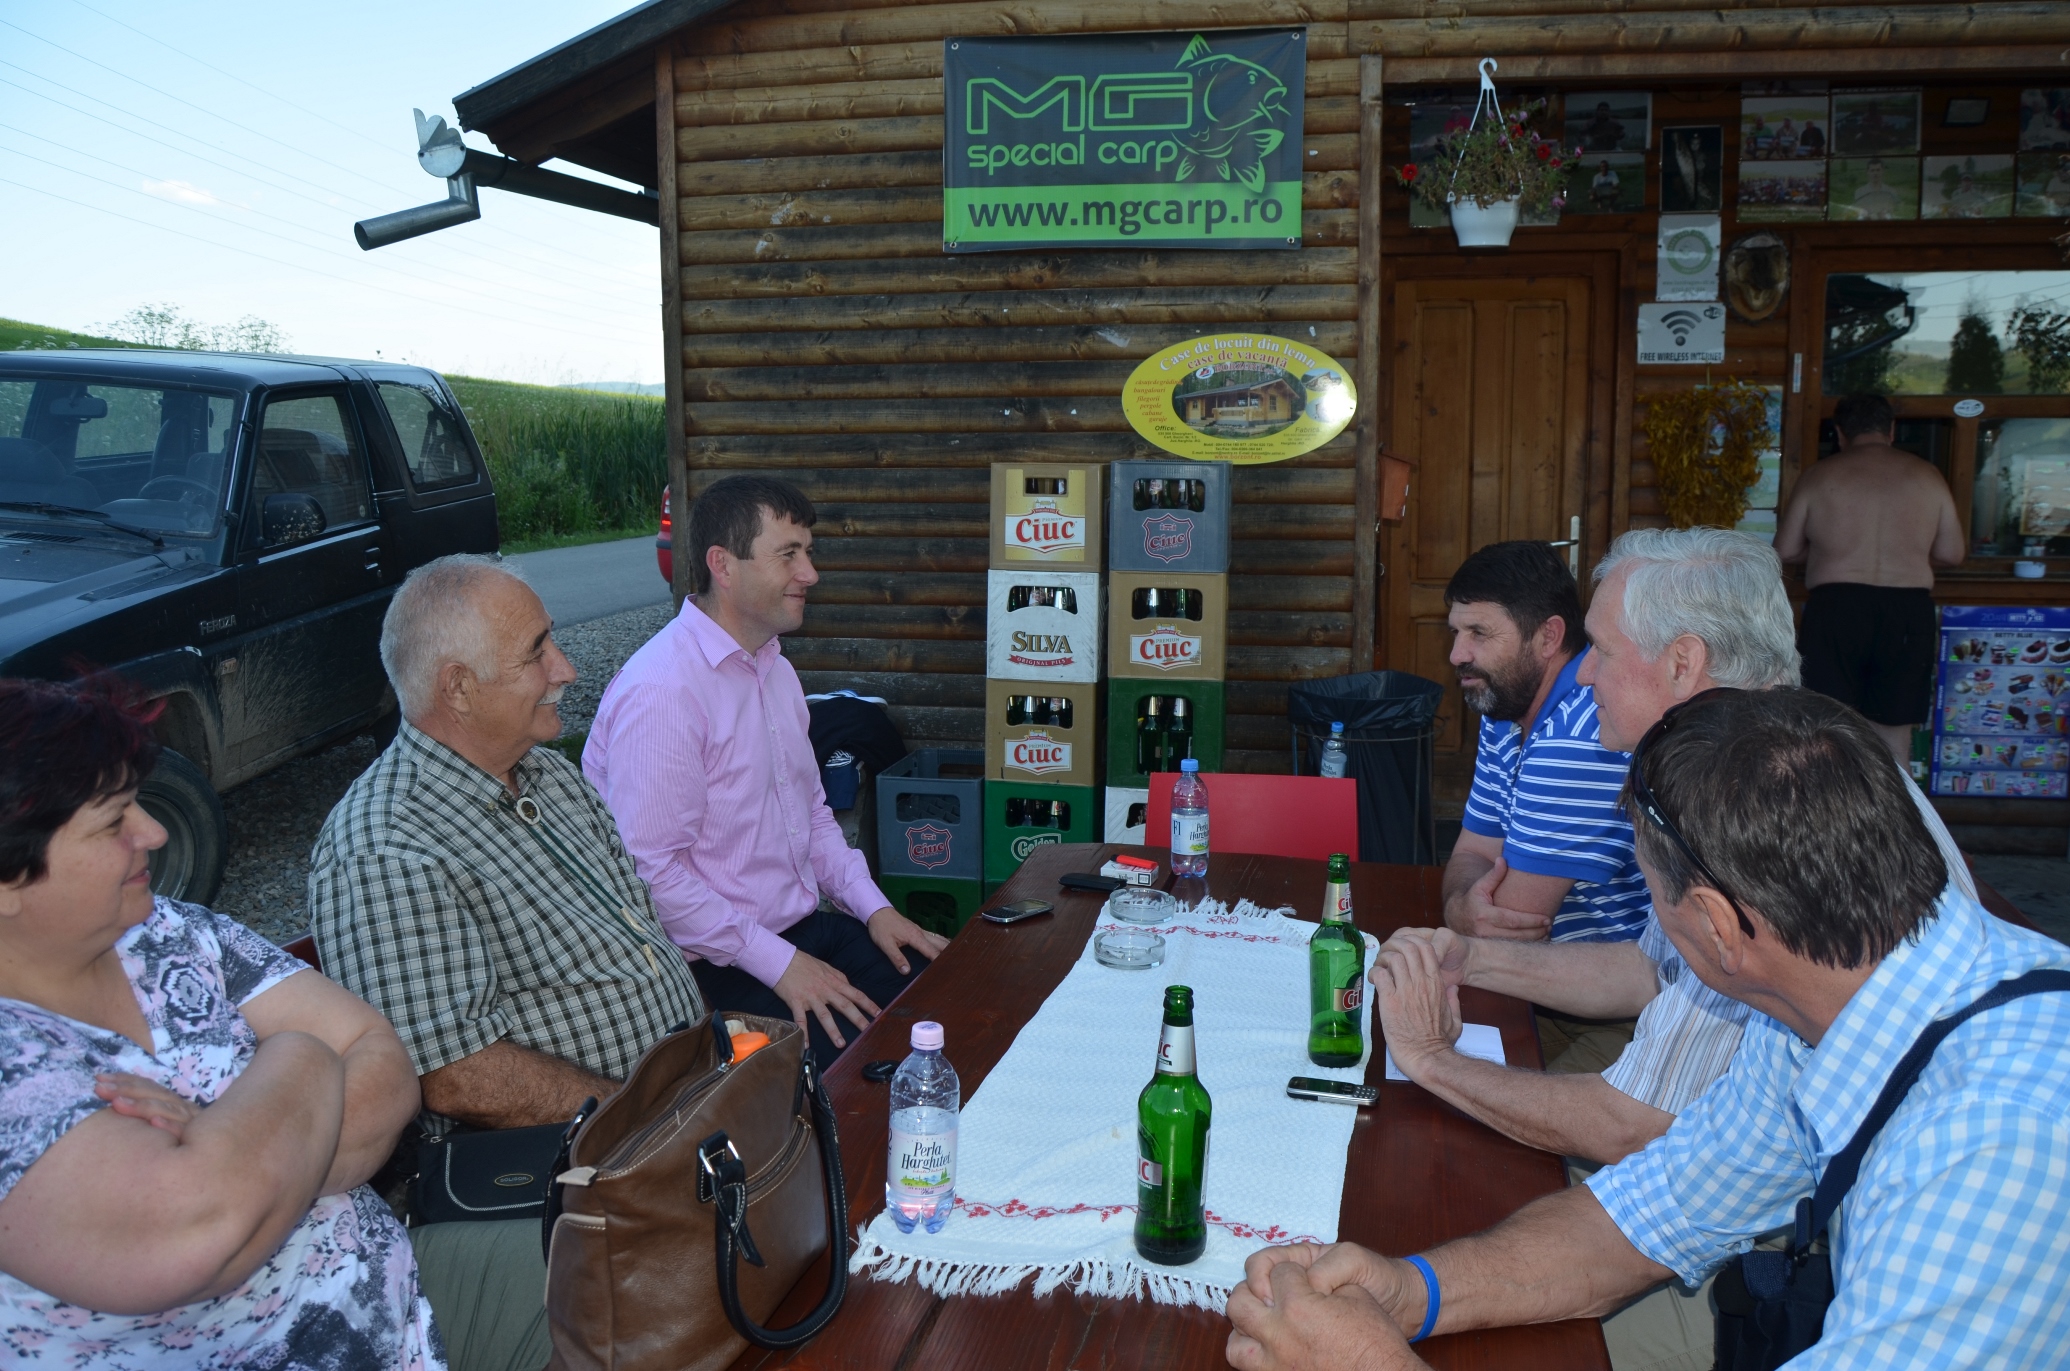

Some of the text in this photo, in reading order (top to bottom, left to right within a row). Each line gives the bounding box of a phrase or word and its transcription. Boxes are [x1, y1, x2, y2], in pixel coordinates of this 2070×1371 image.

[966, 72, 1193, 135] MG
[967, 134, 1178, 176] special carp
[968, 197, 1283, 235] www.mgcarp.ro
[1159, 336, 1317, 371] Case de locuit din lemn
[1187, 354, 1214, 369] case
[1218, 350, 1233, 361] de
[1640, 352, 1722, 361] FREE WIRELESS INTERNET
[1016, 518, 1075, 543] Ciuc
[1149, 533, 1186, 550] Ciuc
[200, 614, 237, 636] FEROZA
[1011, 630, 1073, 654] SILVA
[1140, 638, 1192, 661] Ciuc
[1016, 657, 1049, 666] ORIGINAL
[1014, 743, 1063, 765] Ciuc
[913, 842, 945, 856] Ciuc
[913, 1141, 943, 1158] Perla
[901, 1151, 951, 1173] Harghitei
